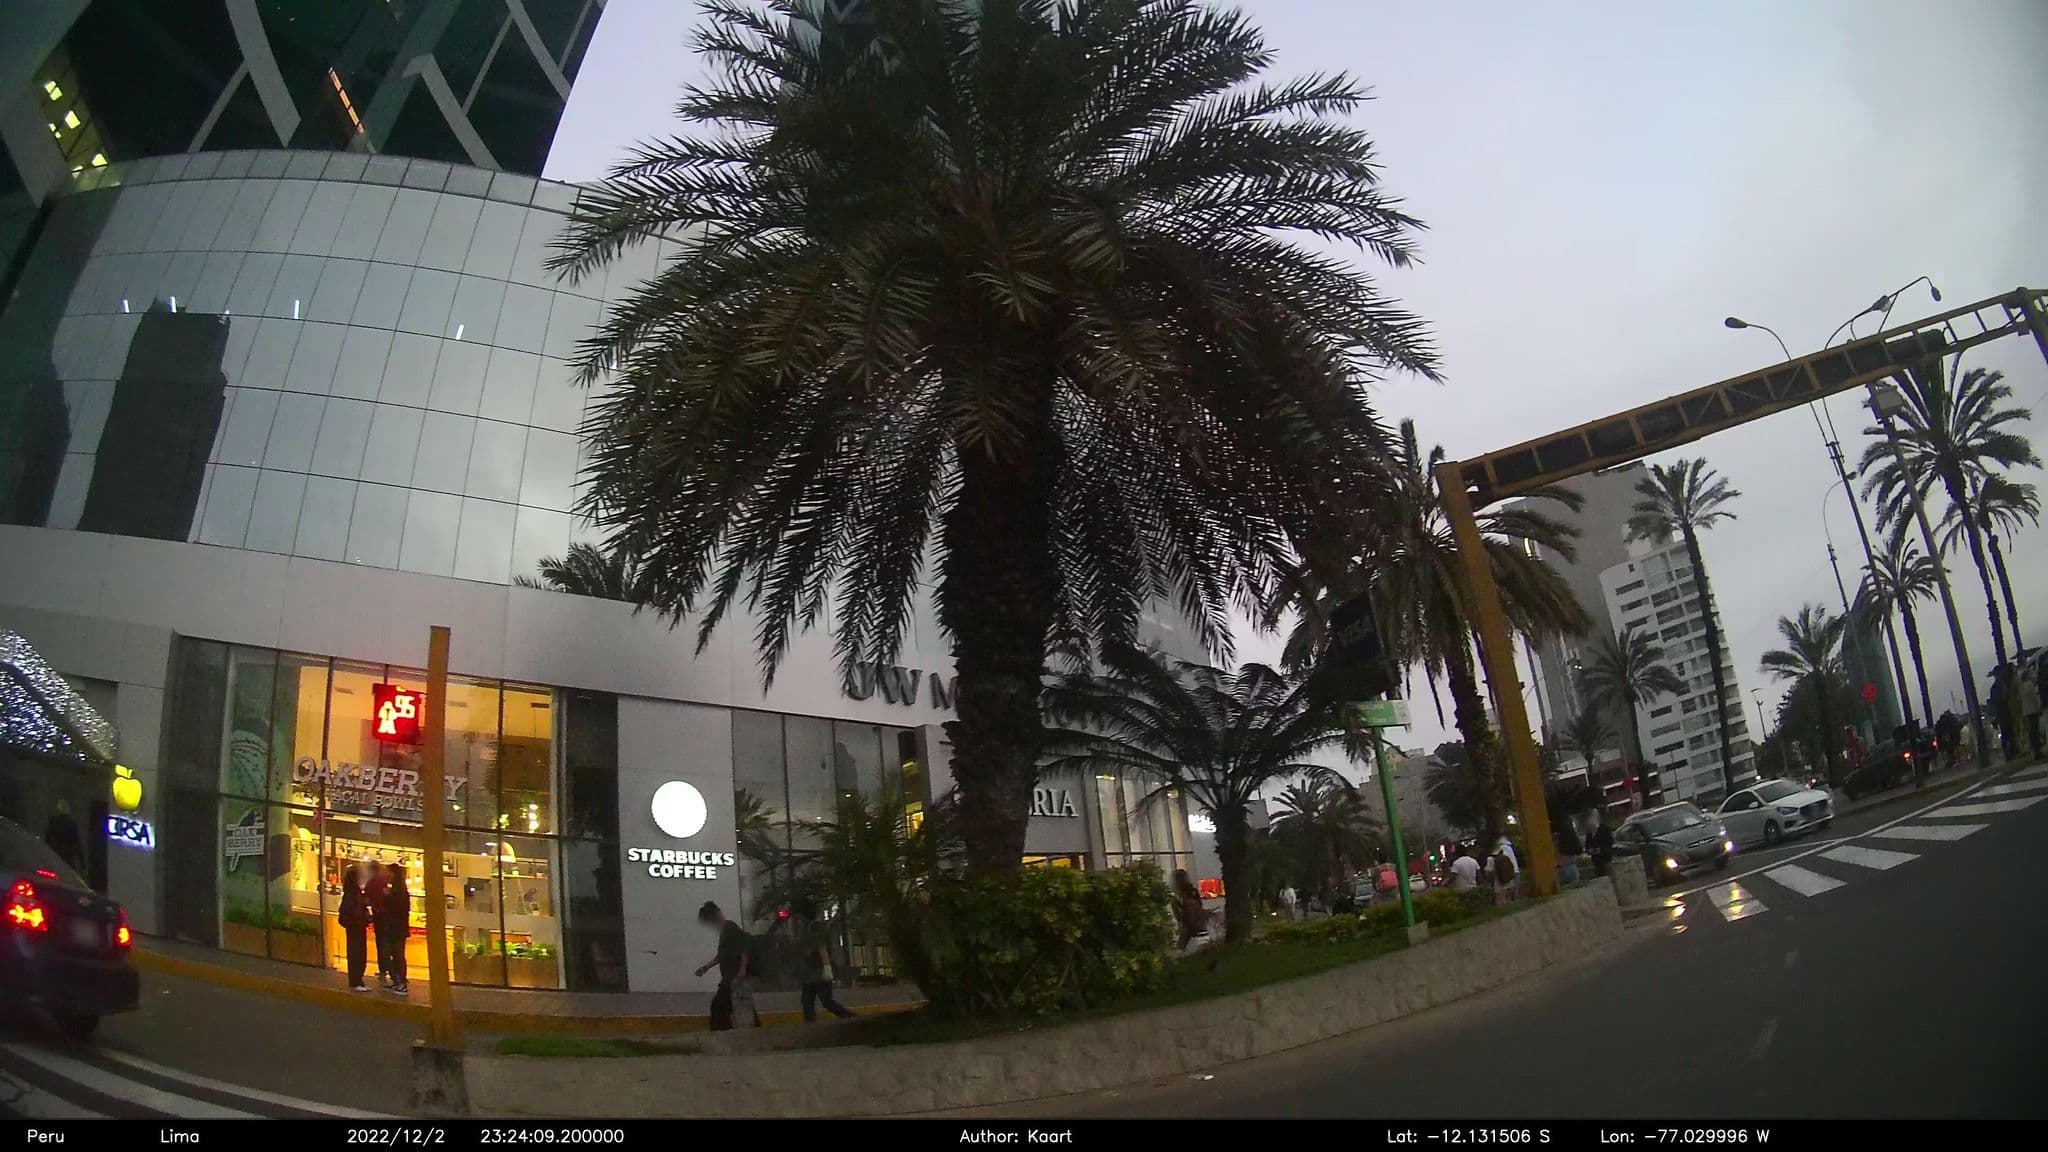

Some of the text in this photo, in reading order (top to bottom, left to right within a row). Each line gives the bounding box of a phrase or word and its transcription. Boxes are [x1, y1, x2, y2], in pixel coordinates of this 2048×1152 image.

[293, 756, 468, 802] OAKBERY
[1028, 787, 1080, 817] RIA
[628, 847, 736, 866] STARBUCKS
[648, 863, 718, 880] COFFEE
